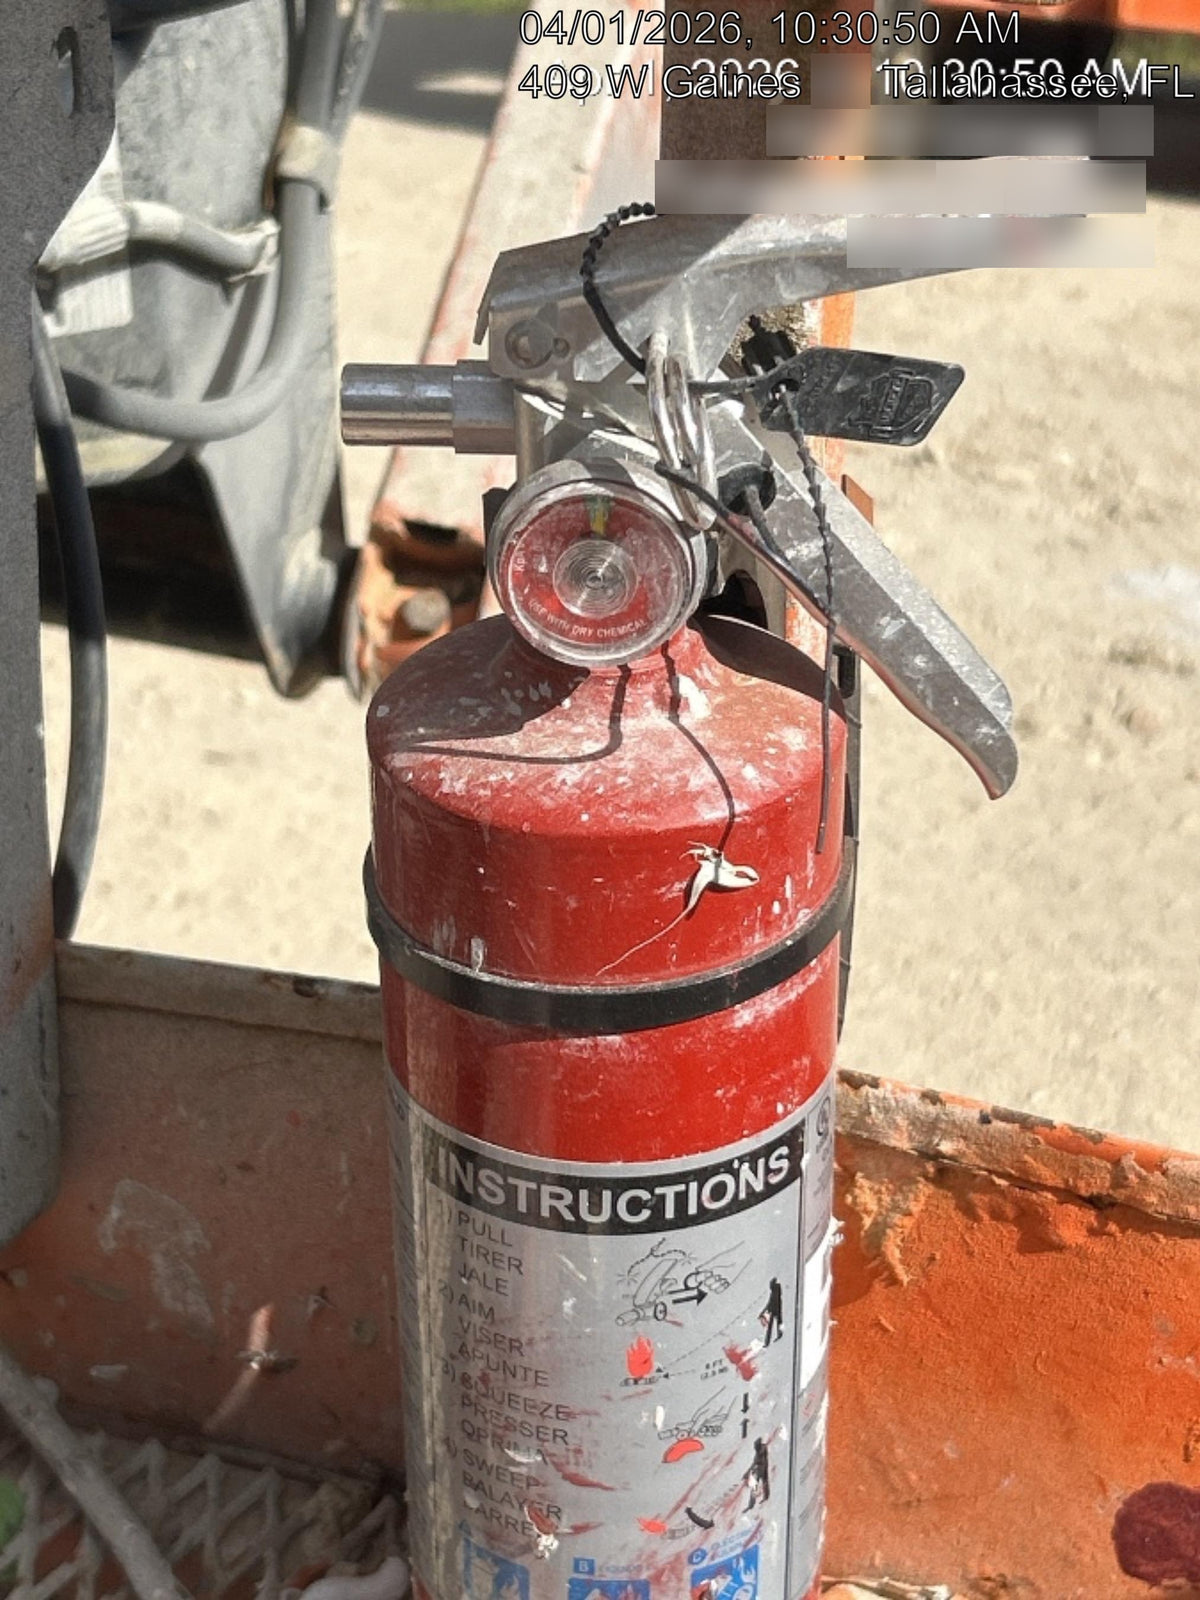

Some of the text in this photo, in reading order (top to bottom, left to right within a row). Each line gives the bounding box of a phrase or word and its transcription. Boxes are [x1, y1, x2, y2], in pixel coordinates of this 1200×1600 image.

[571, 624, 594, 638] DRY
[597, 617, 649, 638] CHEMICAL
[438, 1144, 791, 1225] INSTRUCTIONS
[457, 1209, 513, 1248] PULL
[458, 1235, 524, 1276] TIRER
[458, 1262, 509, 1297] JALE
[458, 1293, 495, 1325] AIM
[458, 1315, 525, 1357] VISER
[458, 1342, 550, 1388] APUNTE
[460, 1371, 571, 1422] SQUEEZE
[461, 1394, 569, 1446] PRESSER
[462, 1448, 543, 1491] SWEEP
[577, 1559, 590, 1573] B
